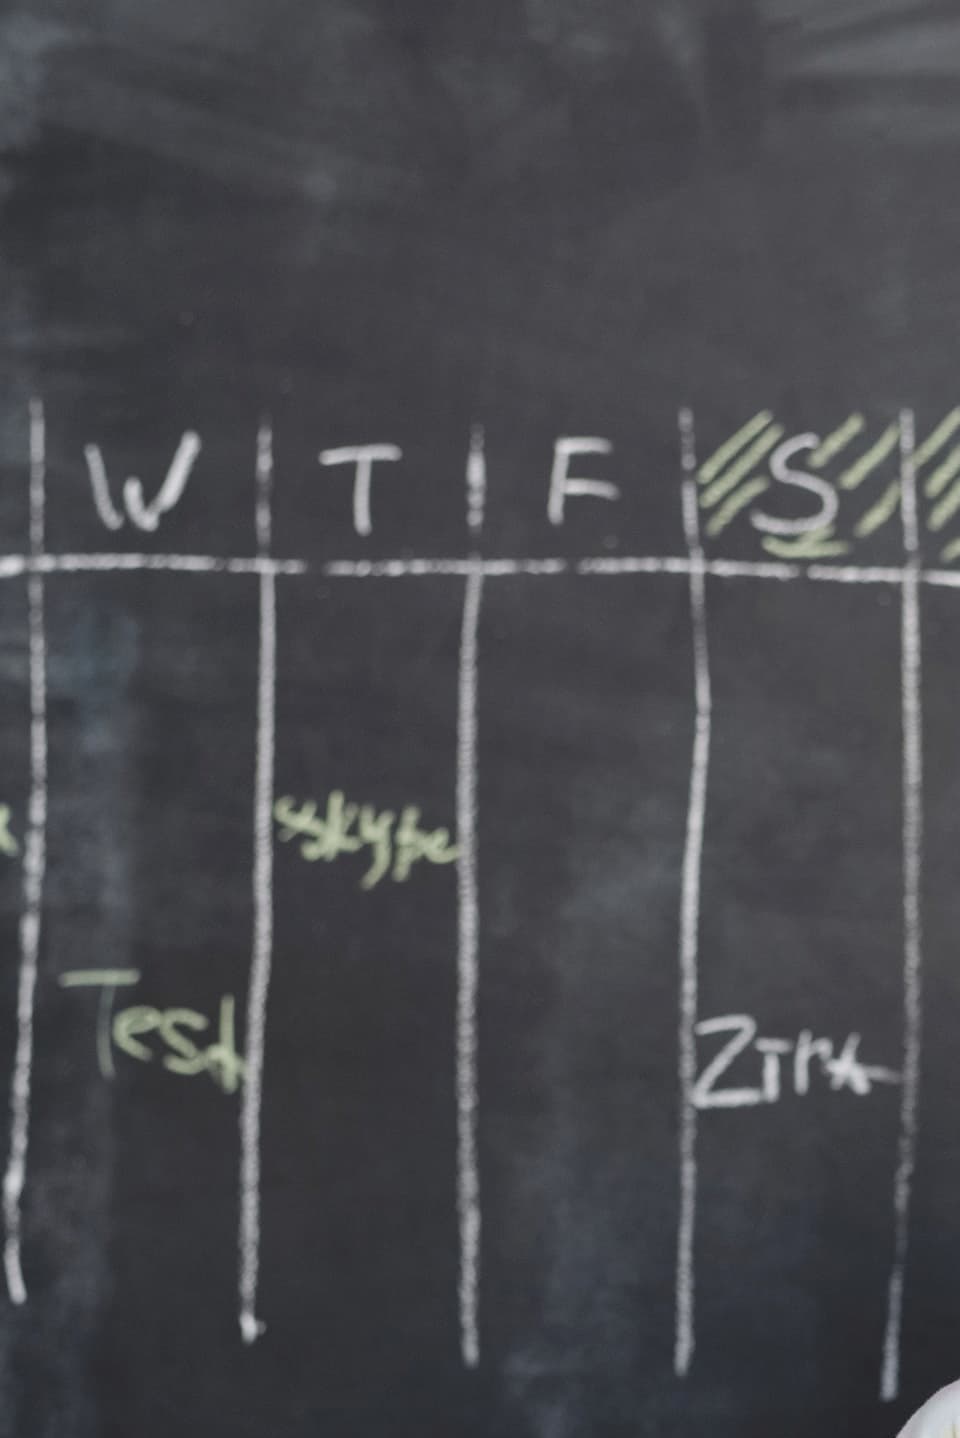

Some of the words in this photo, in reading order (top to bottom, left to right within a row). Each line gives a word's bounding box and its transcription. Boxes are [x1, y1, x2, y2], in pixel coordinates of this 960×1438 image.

[83, 429, 200, 530] W
[319, 442, 401, 536] T
[547, 436, 620, 525] F
[749, 431, 839, 535] S
[57, 968, 249, 1095] Test
